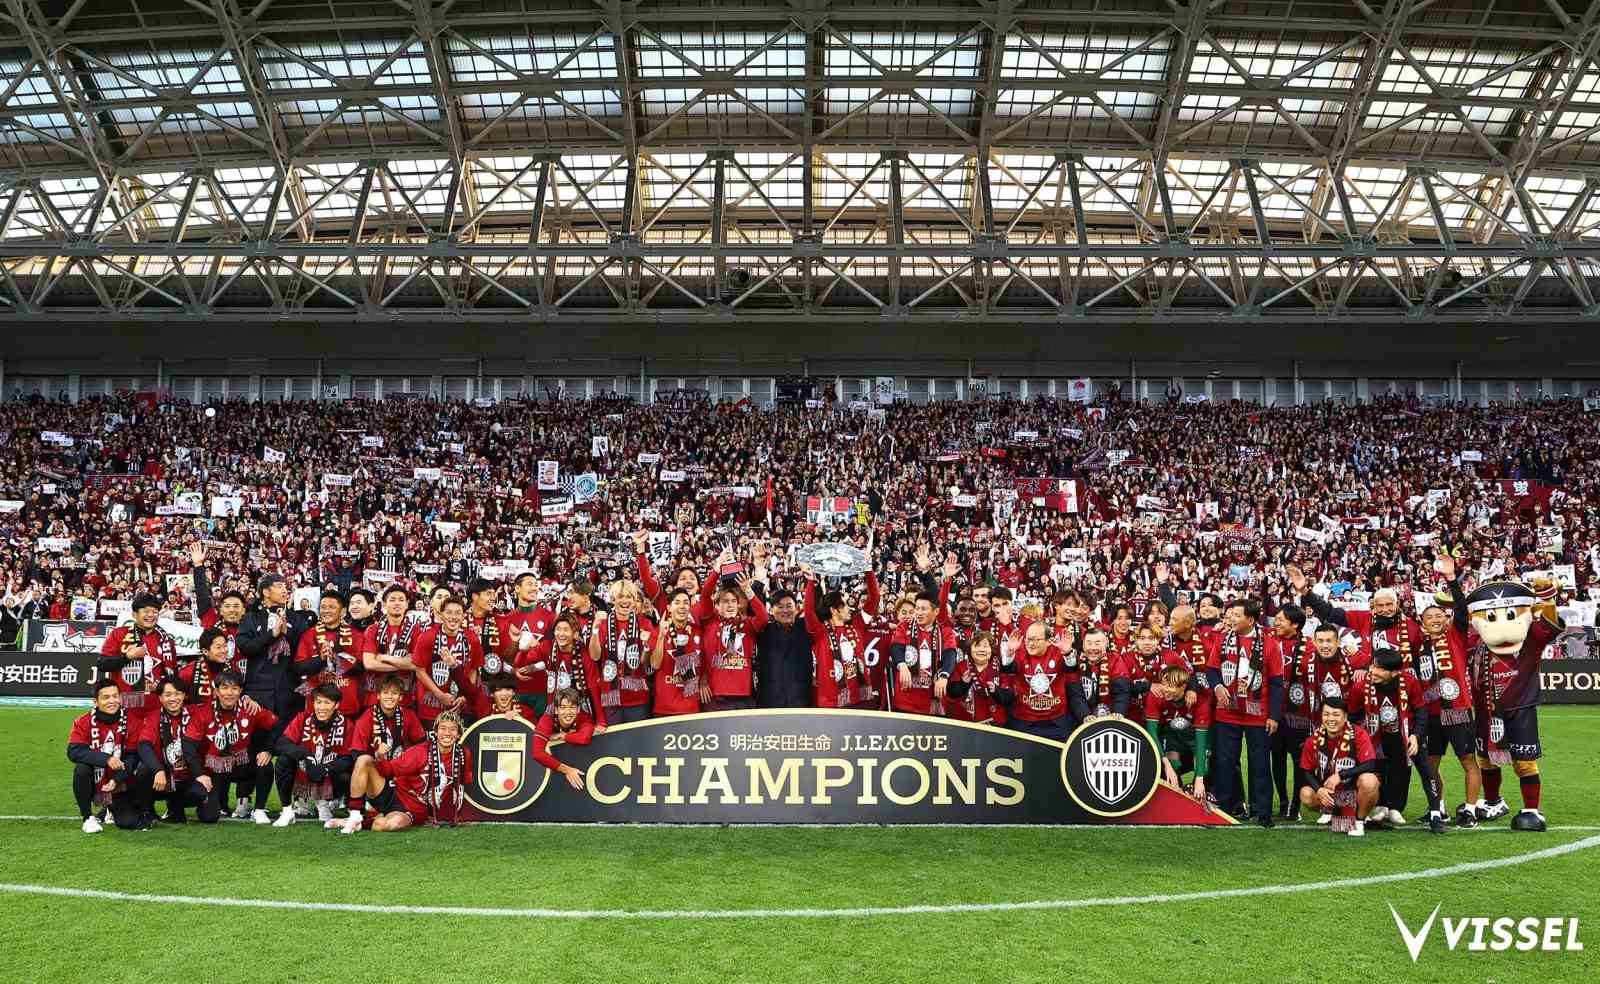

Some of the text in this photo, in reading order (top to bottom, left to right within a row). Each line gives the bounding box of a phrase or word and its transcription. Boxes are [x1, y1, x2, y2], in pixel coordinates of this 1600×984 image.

[663, 734, 947, 751] 2023 明治安田生命 J.LEAGUE
[1100, 758, 1134, 768] VISSEL
[585, 756, 1025, 806] CHAMPIONS
